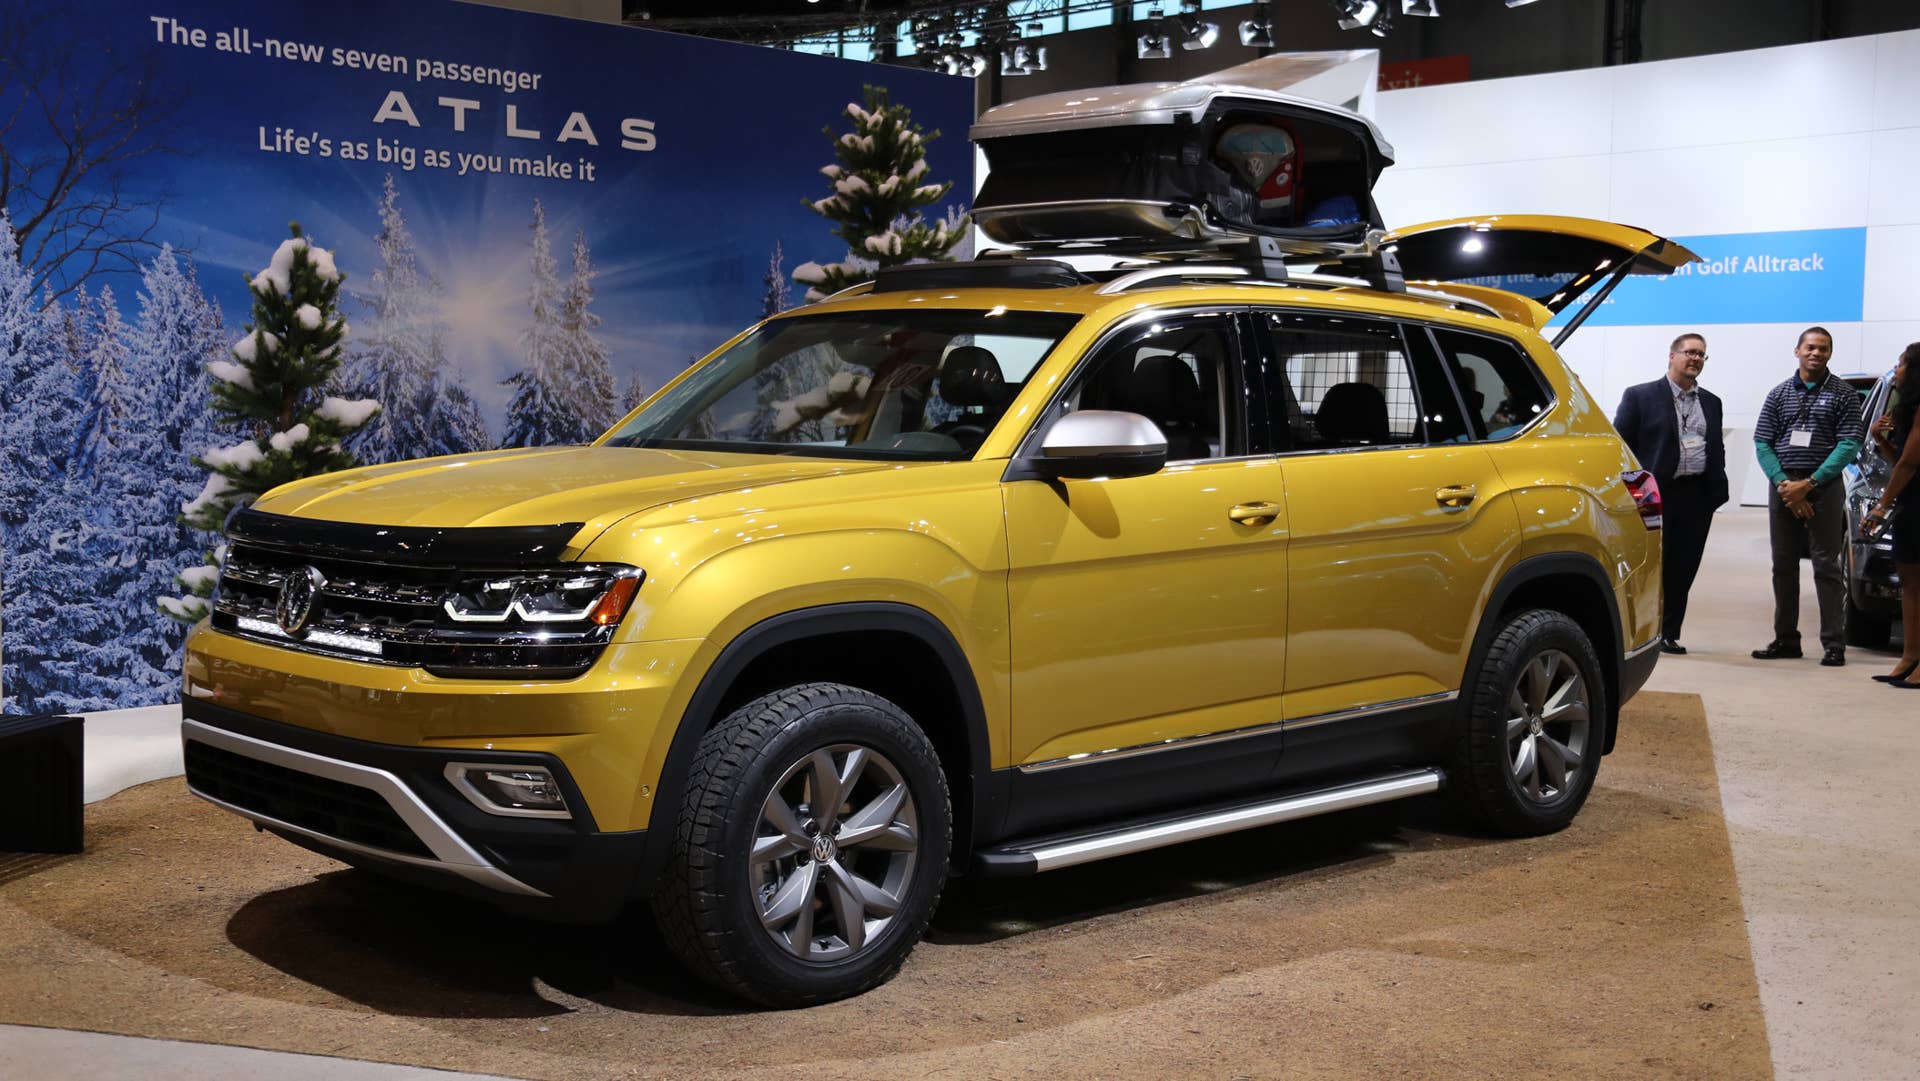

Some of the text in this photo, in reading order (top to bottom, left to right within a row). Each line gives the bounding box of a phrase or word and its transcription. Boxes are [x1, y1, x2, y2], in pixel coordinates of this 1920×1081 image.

[150, 16, 542, 93] The all-new seven passenger
[372, 90, 657, 152] ATLAS
[258, 126, 596, 181] Life's as big as you make it
[1697, 256, 1739, 275] Golf
[1743, 252, 1825, 273] Alltrack
